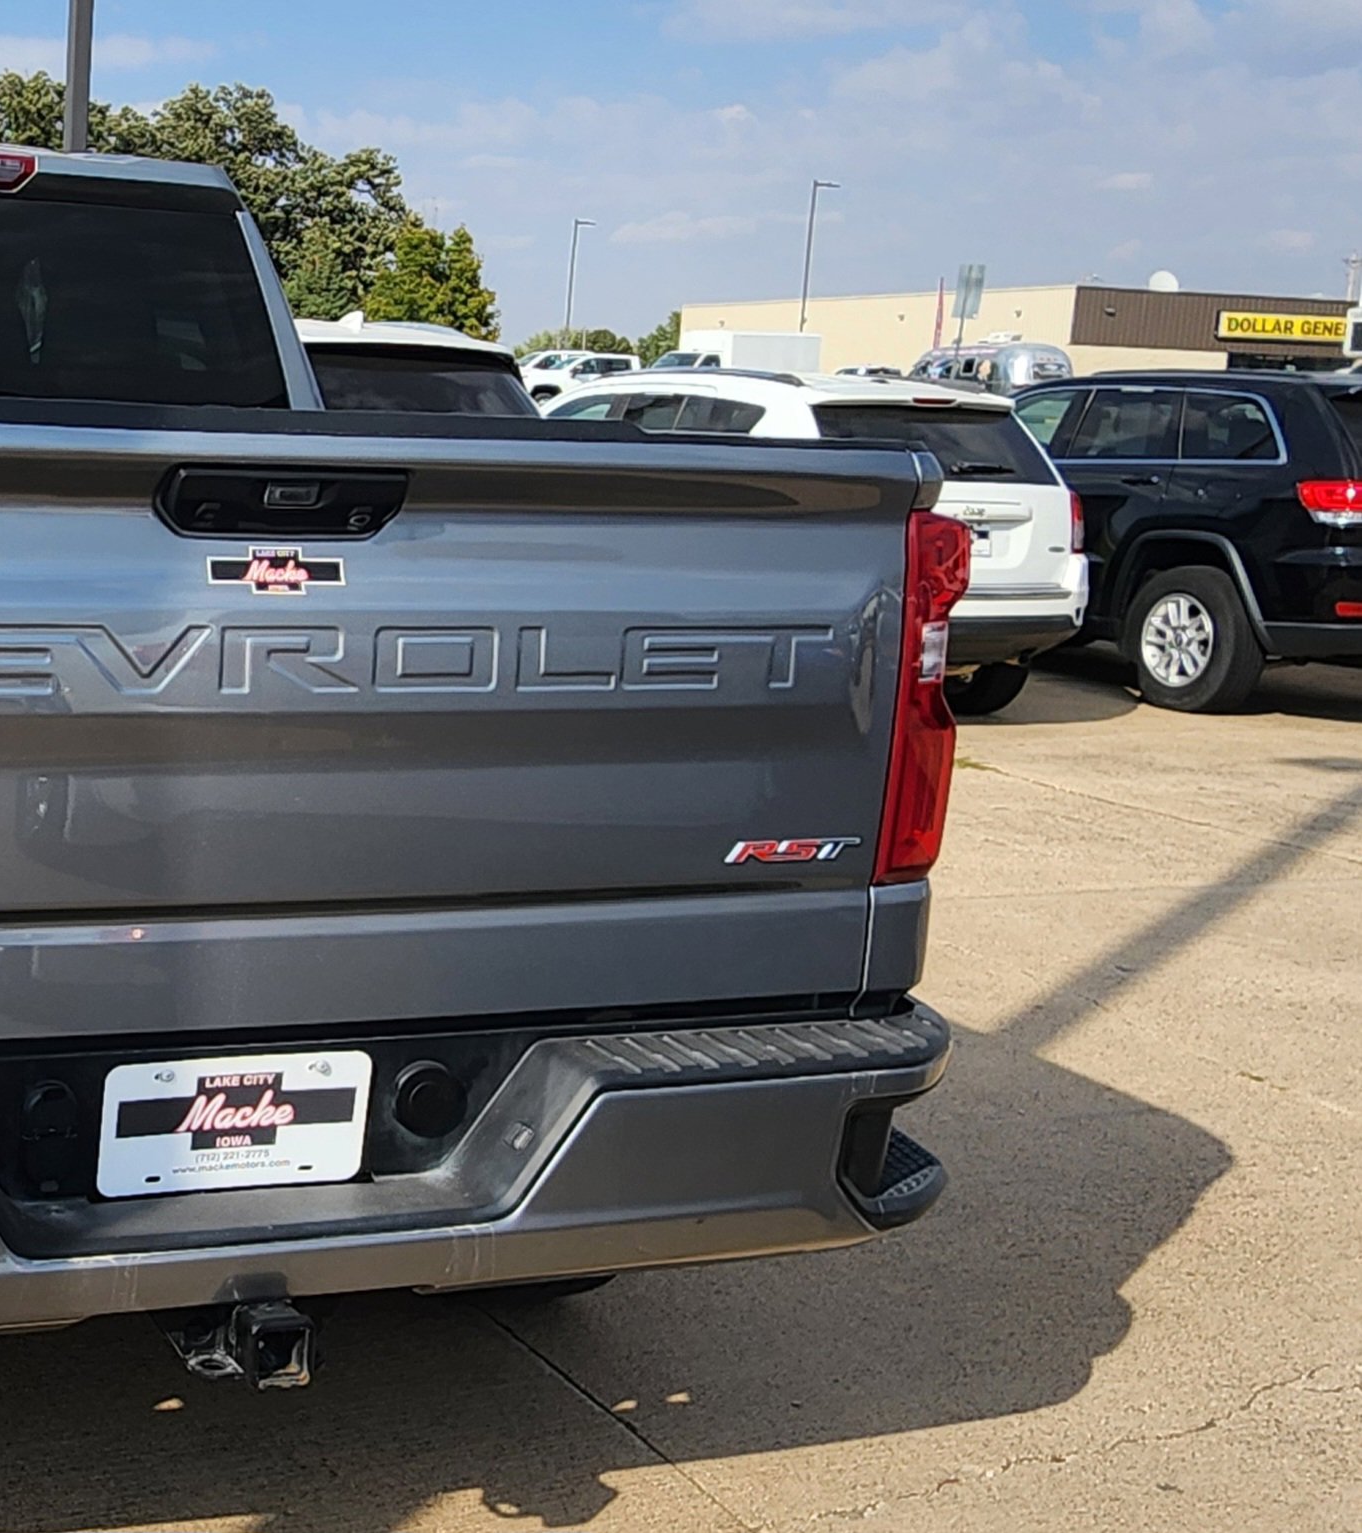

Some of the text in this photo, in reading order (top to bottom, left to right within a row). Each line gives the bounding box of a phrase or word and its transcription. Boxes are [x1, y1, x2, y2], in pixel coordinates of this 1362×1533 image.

[1227, 317, 1347, 337] DOLLAR GENE
[242, 559, 309, 583] Macke
[724, 837, 861, 864] RST
[205, 1073, 276, 1089] LAKE CITY
[174, 1088, 295, 1133] Macke
[216, 1134, 253, 1148] IOWA
[172, 1158, 291, 1175] www.mackemotors.com
